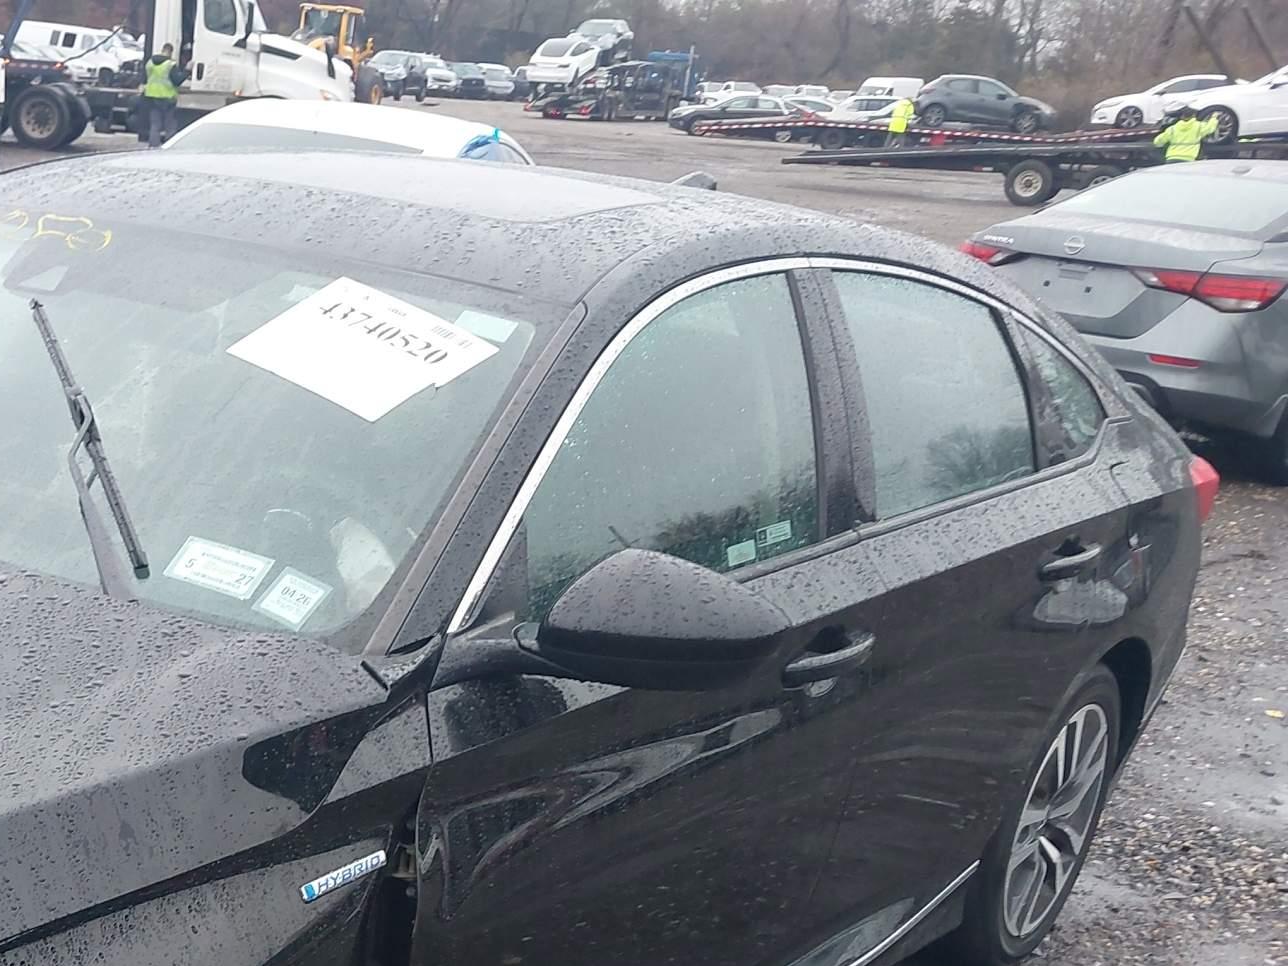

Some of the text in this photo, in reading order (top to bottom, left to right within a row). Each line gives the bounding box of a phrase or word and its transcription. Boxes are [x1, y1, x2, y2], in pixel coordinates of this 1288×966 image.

[318, 301, 449, 365] 43740520
[234, 572, 255, 587] 27
[317, 855, 381, 894] HYBRID
